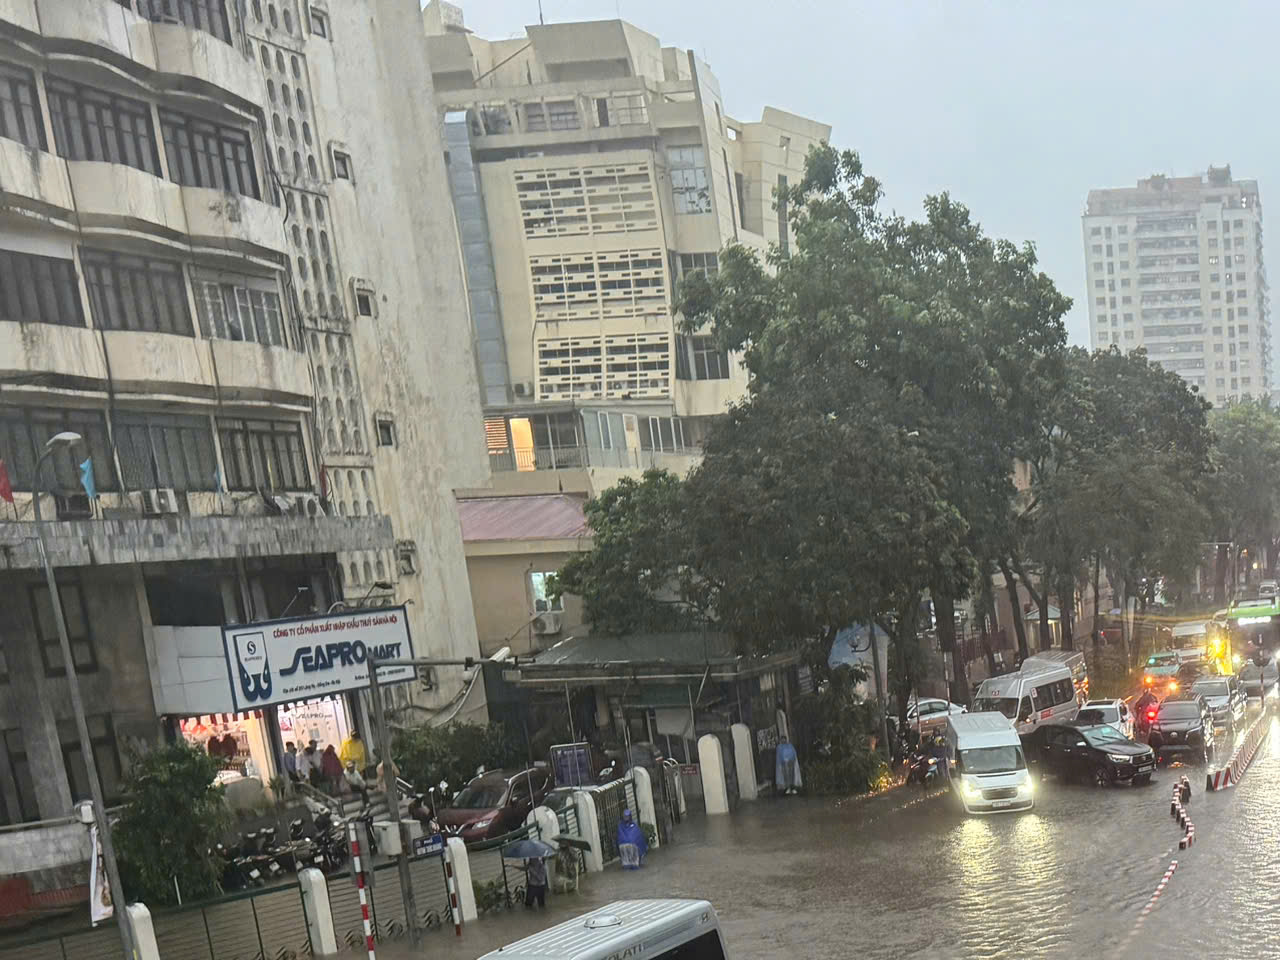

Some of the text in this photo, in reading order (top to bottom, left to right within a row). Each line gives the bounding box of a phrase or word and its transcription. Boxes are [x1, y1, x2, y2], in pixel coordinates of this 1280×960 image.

[273, 628, 289, 638] CÔNG
[279, 640, 367, 677] SEAPRO
[367, 641, 402, 660] MART
